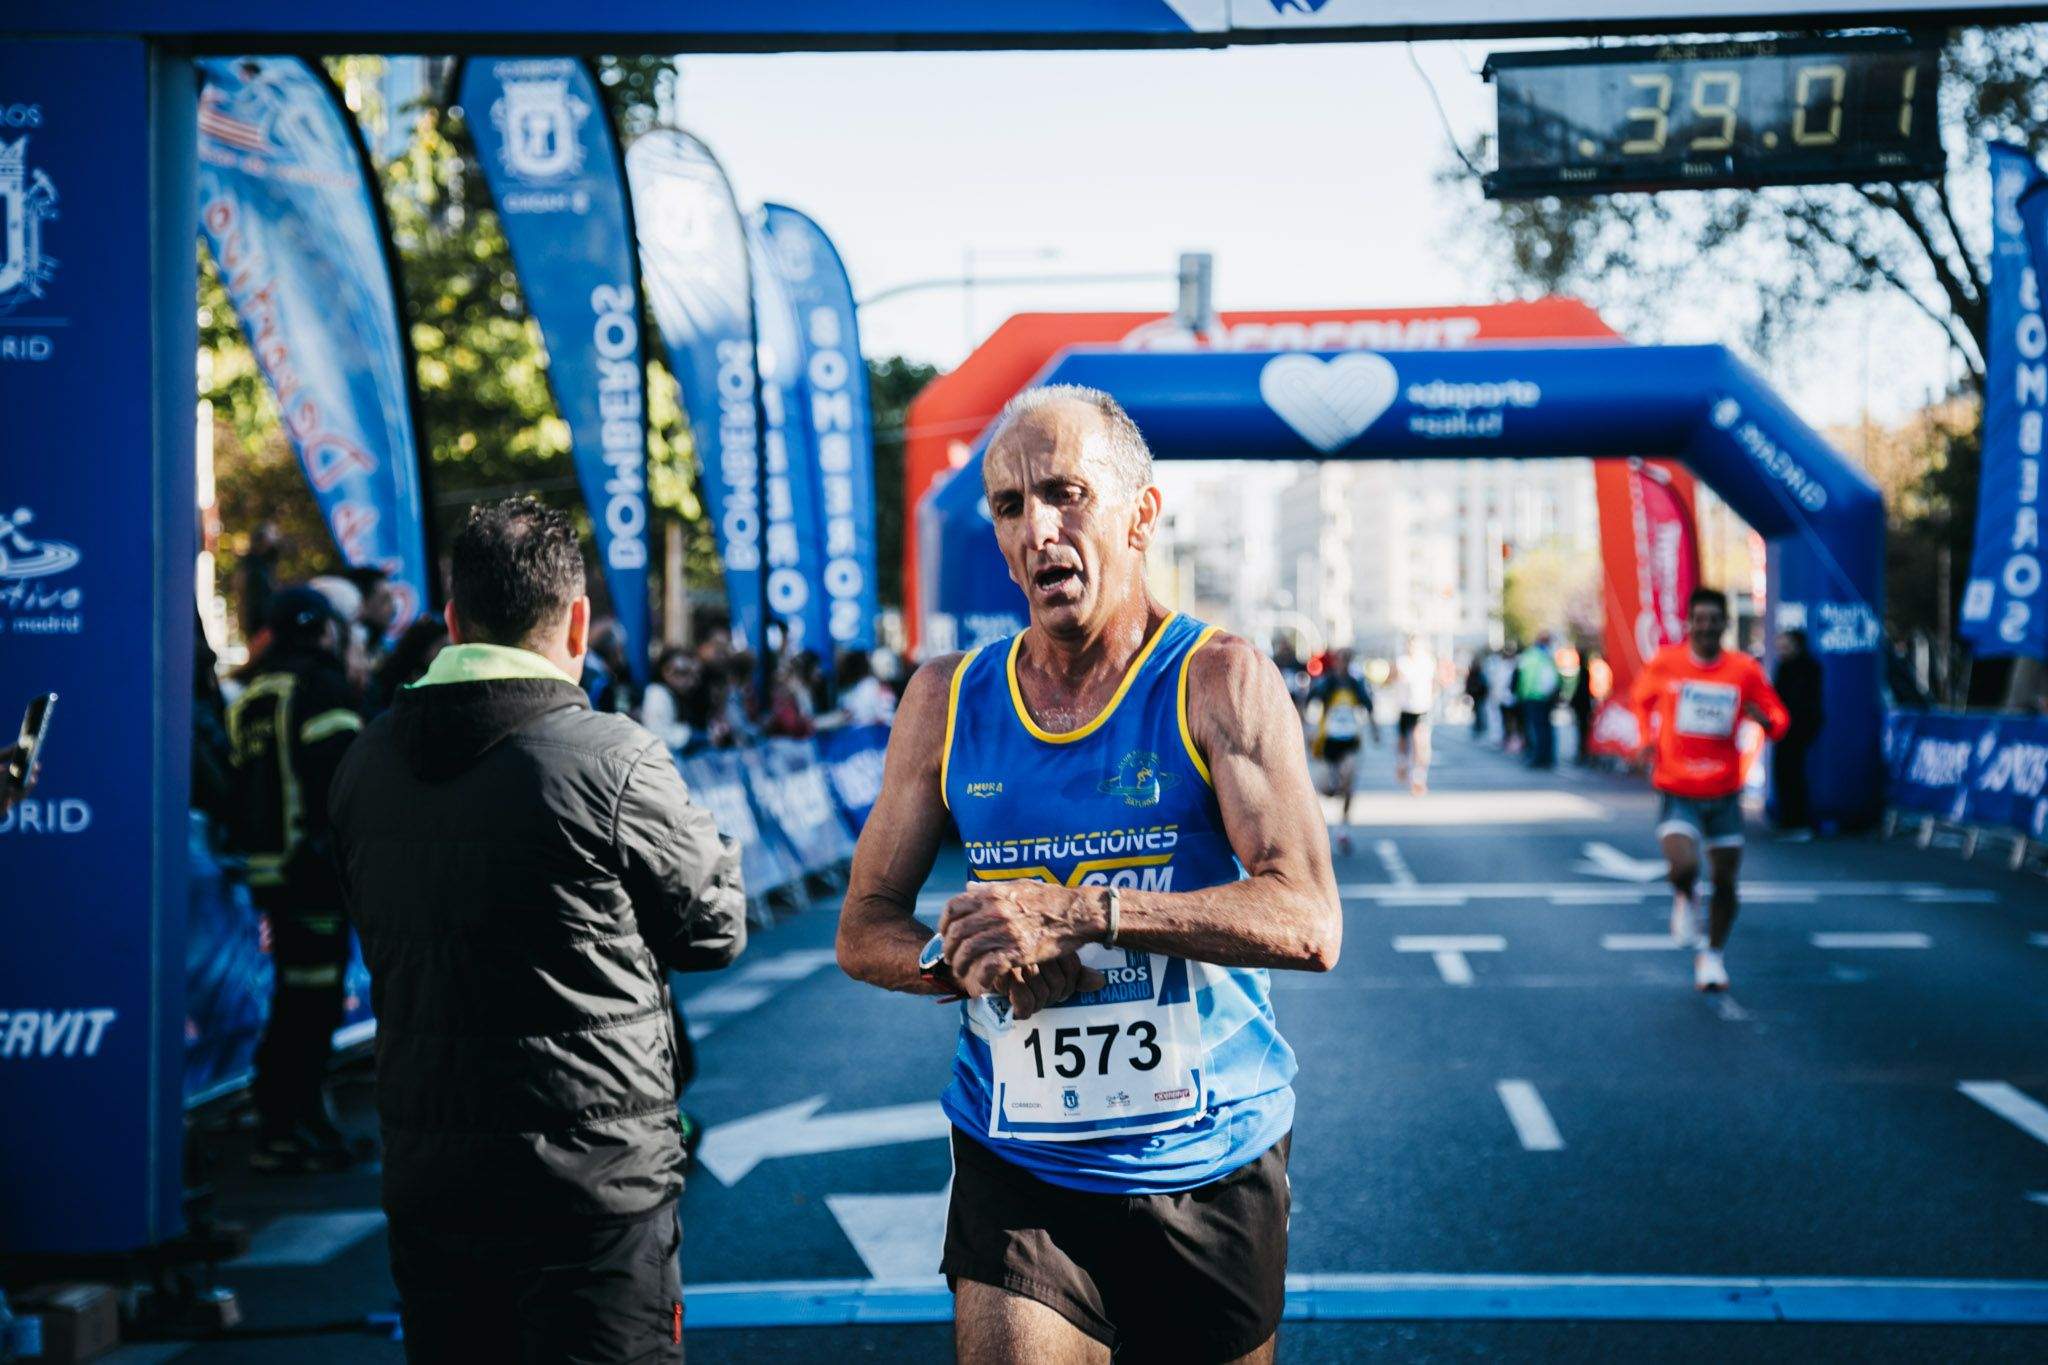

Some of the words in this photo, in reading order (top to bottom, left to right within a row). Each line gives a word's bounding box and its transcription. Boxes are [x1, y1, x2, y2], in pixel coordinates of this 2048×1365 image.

[1101, 966, 1149, 985] ROS
[1101, 981, 1151, 1001] MADRID
[1023, 1020, 1163, 1079] 1573
